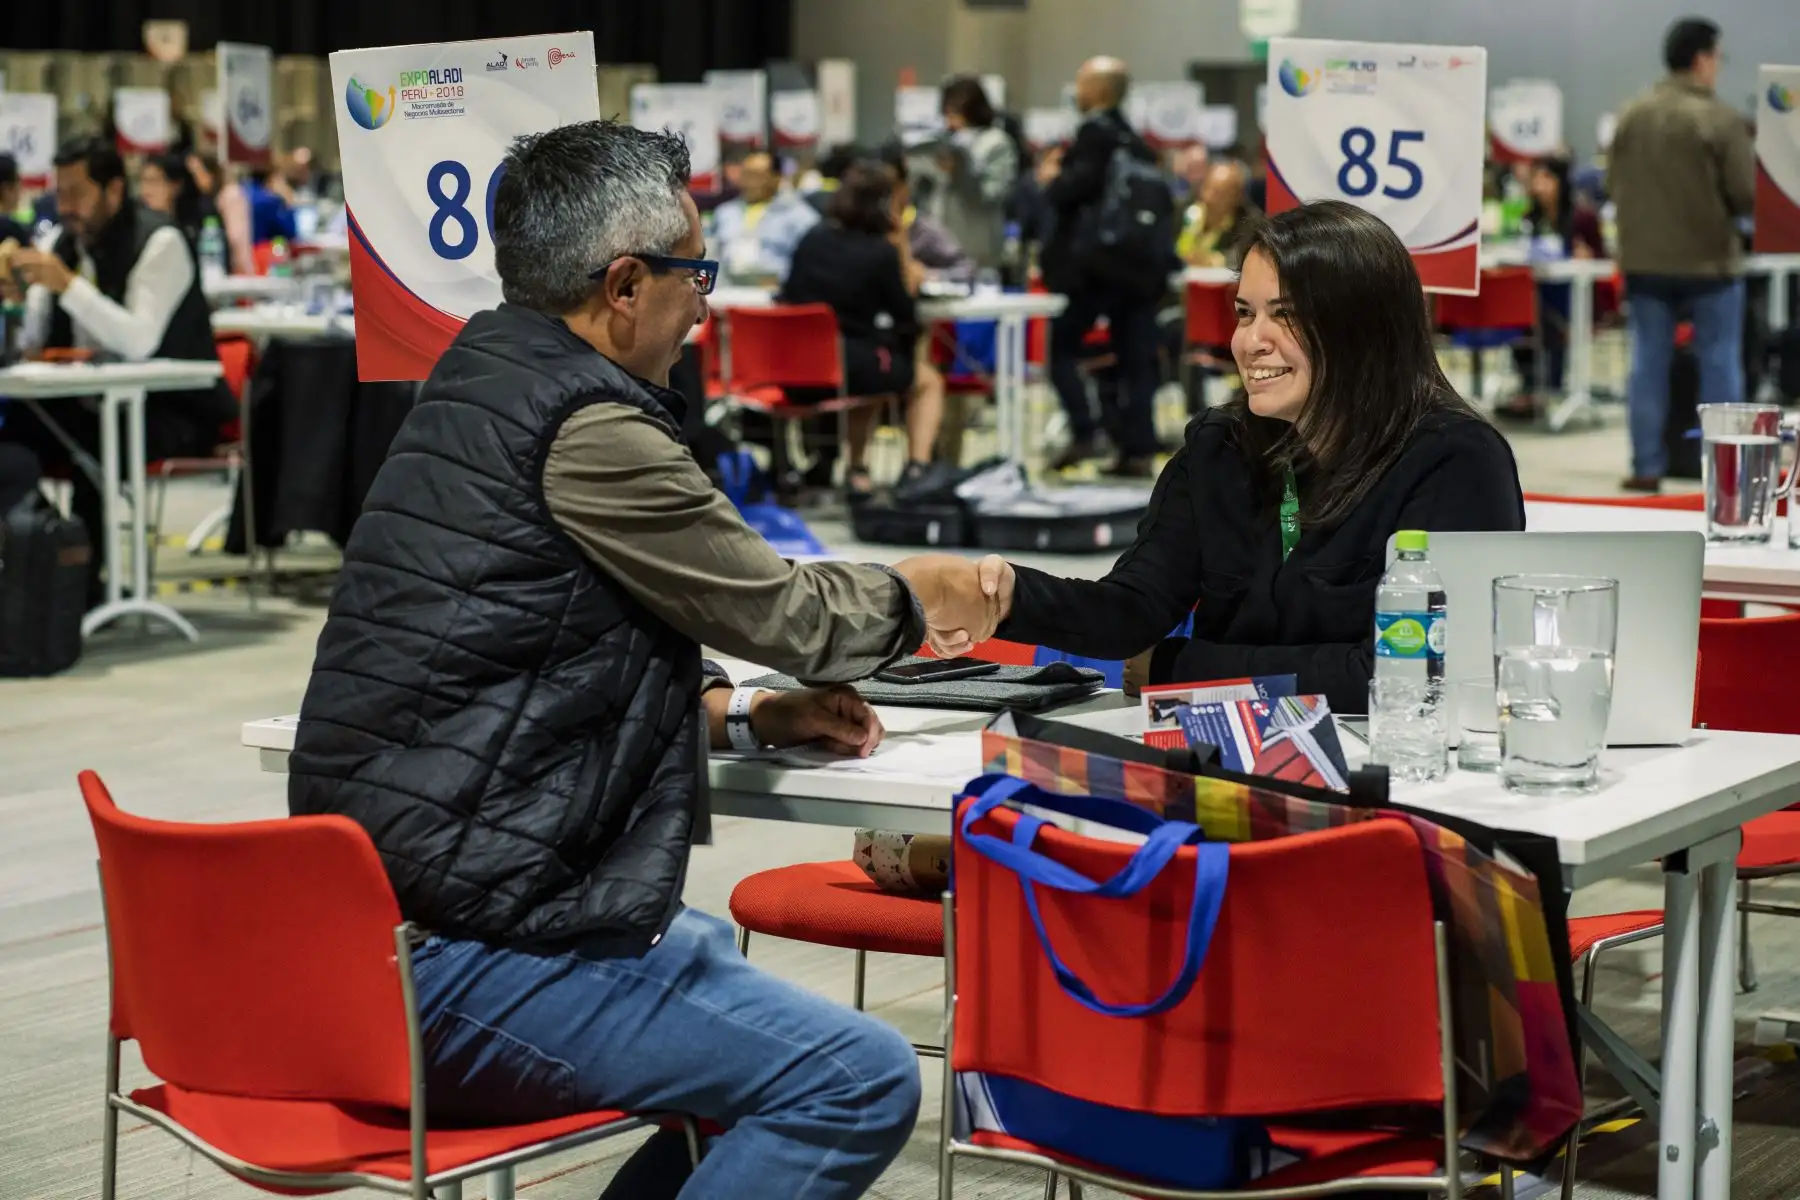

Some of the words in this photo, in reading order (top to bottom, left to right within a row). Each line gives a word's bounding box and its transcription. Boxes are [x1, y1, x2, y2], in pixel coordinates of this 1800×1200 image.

[400, 68, 463, 87] EXPOALADI
[402, 87, 428, 100] PERÚ
[437, 85, 464, 98] 2018
[1337, 126, 1425, 200] 85
